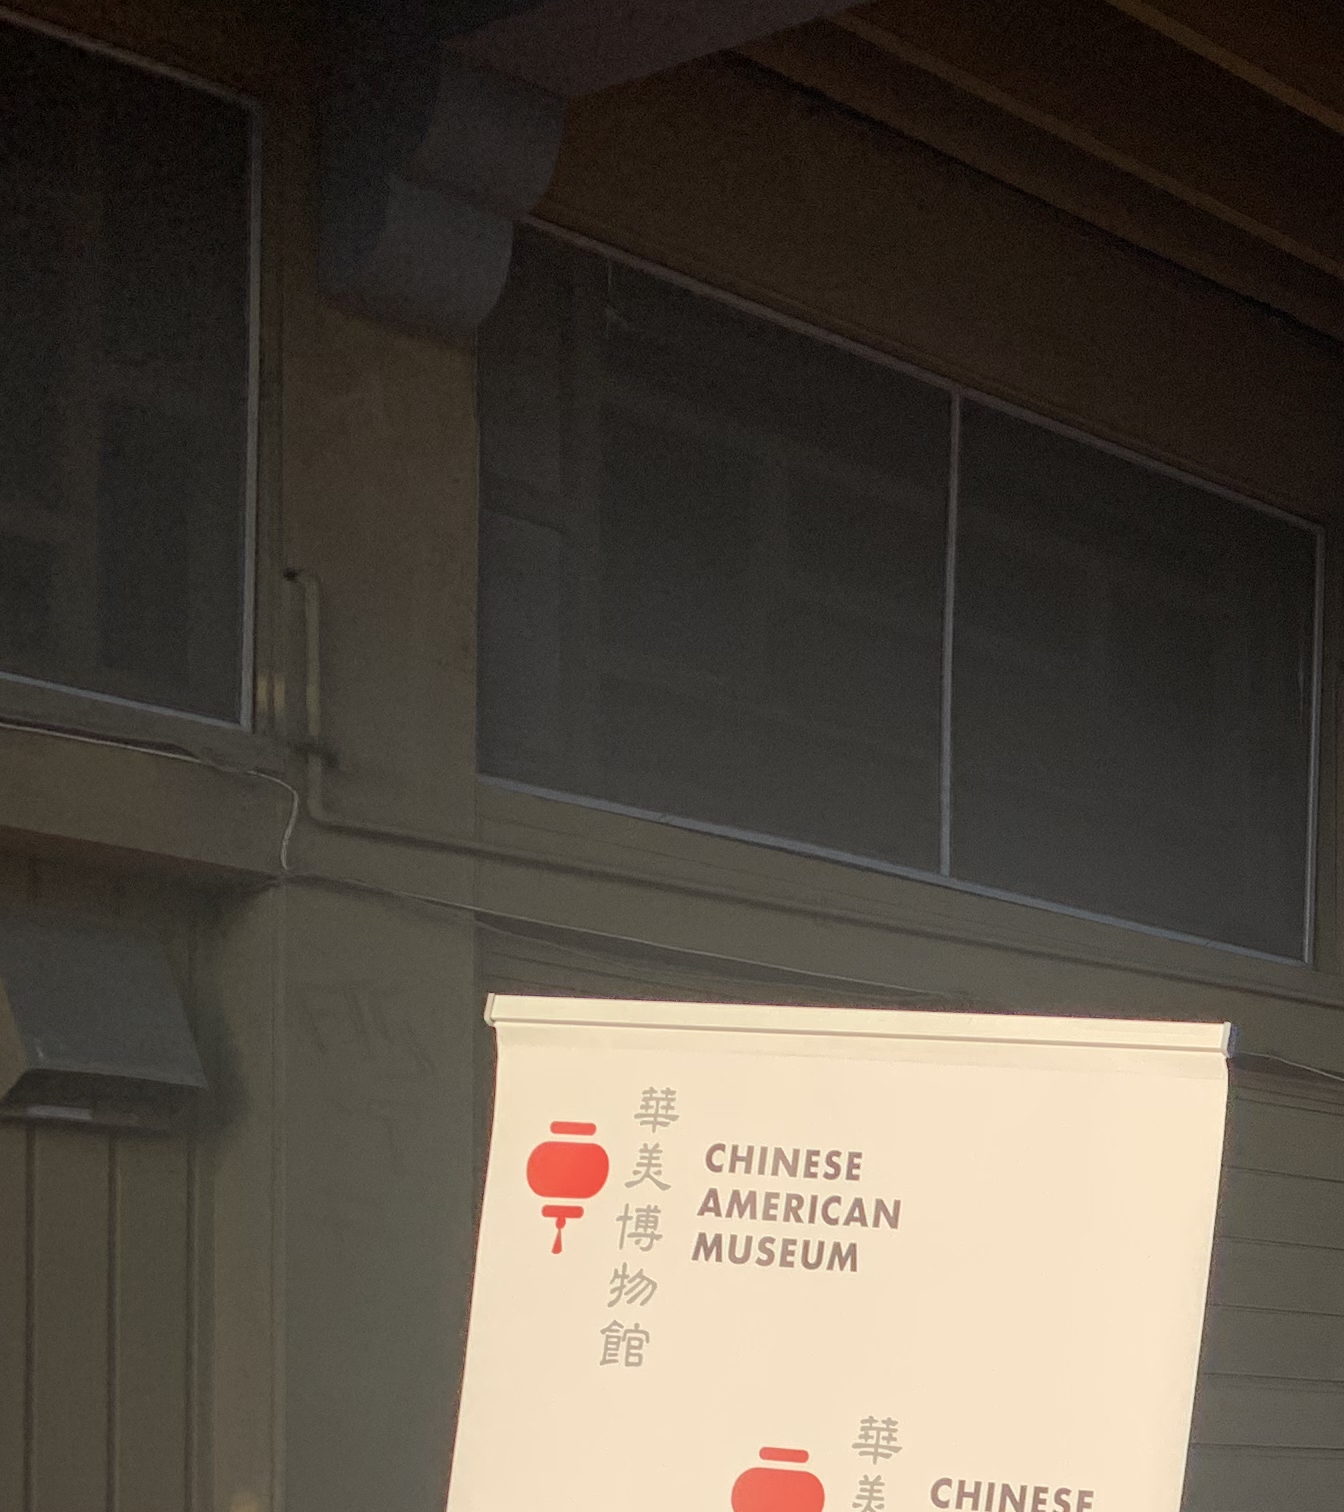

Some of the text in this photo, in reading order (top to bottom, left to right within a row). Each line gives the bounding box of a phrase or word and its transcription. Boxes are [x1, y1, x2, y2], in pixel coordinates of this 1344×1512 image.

[705, 1143, 862, 1181] CHINESE
[600, 1087, 679, 1367] 華美博物館
[697, 1188, 901, 1229] AMERICAN
[691, 1232, 857, 1272] MUSEUM
